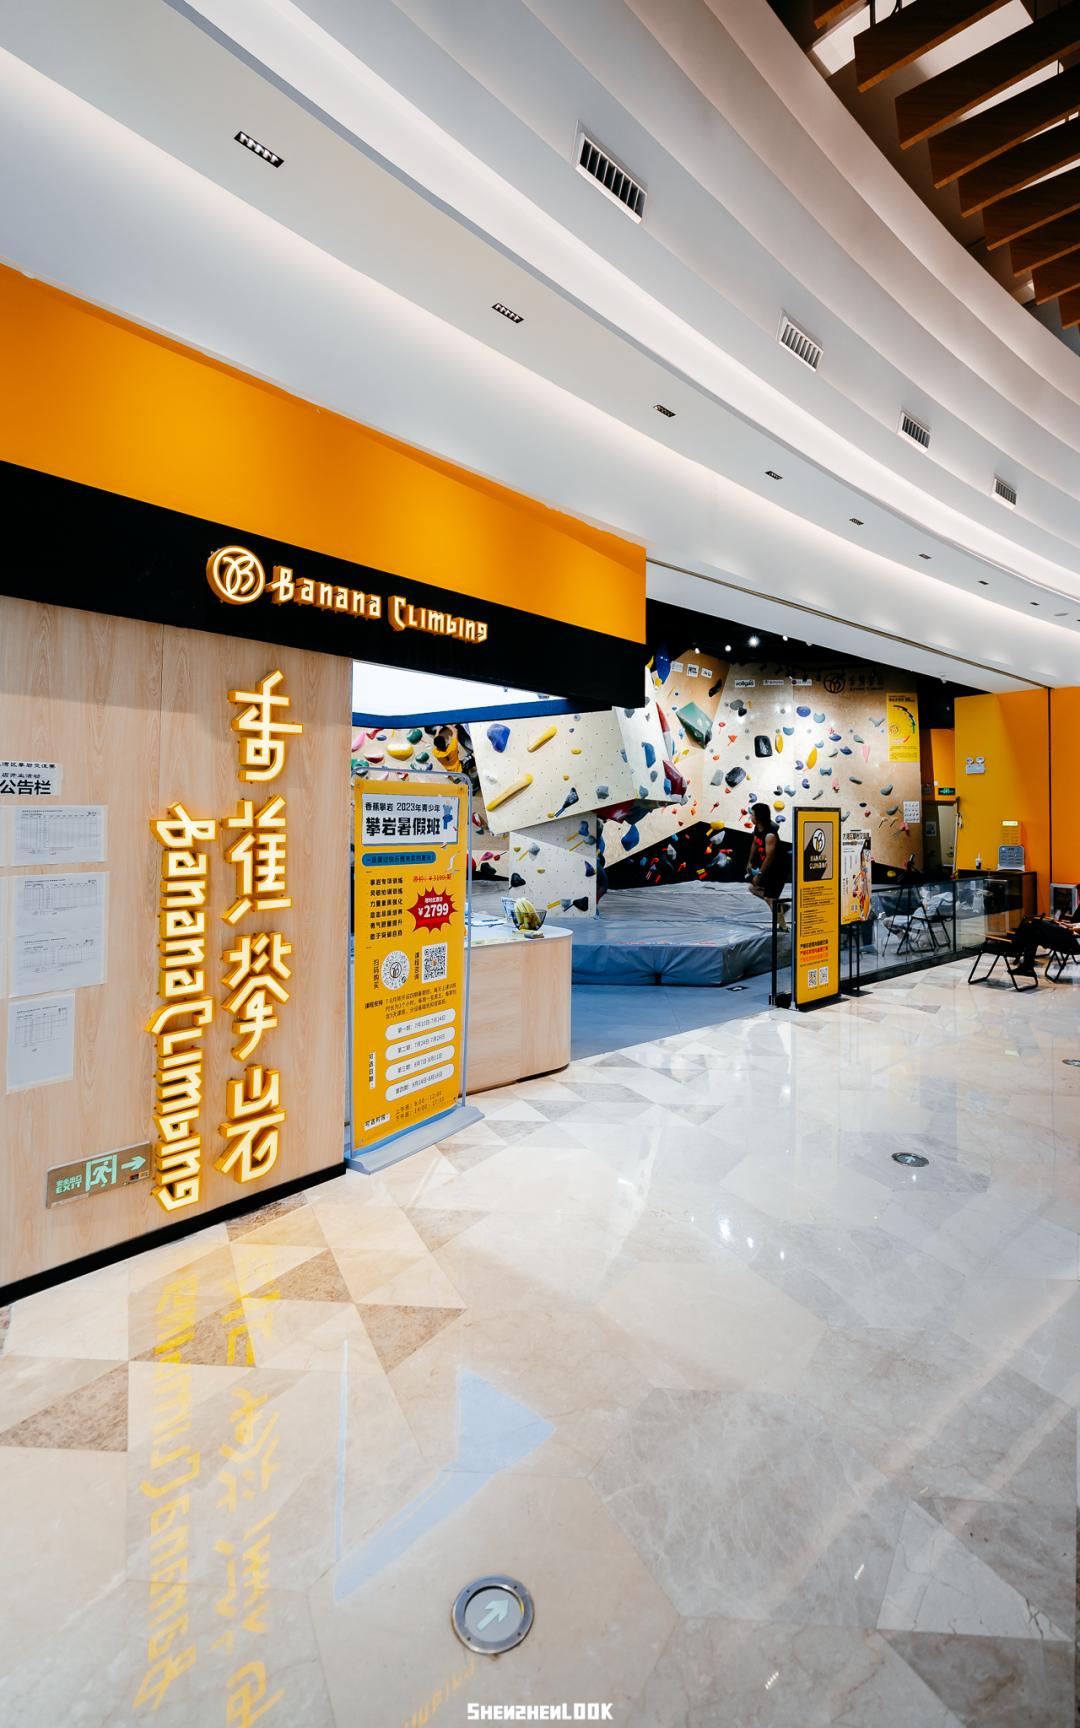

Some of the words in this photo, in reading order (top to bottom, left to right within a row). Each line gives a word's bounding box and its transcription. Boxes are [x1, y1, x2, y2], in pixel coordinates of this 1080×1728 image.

[265, 565, 382, 620] Banana
[0, 779, 51, 795] 公告栏
[365, 802, 394, 812] 香蕉攀岩
[396, 802, 441, 812] 2023年青少年
[366, 816, 440, 836] 攀岩暑假班
[418, 903, 449, 918] ¥2799
[215, 670, 304, 1184] 香蕉攀岩
[55, 1182, 81, 1194] EXIT
